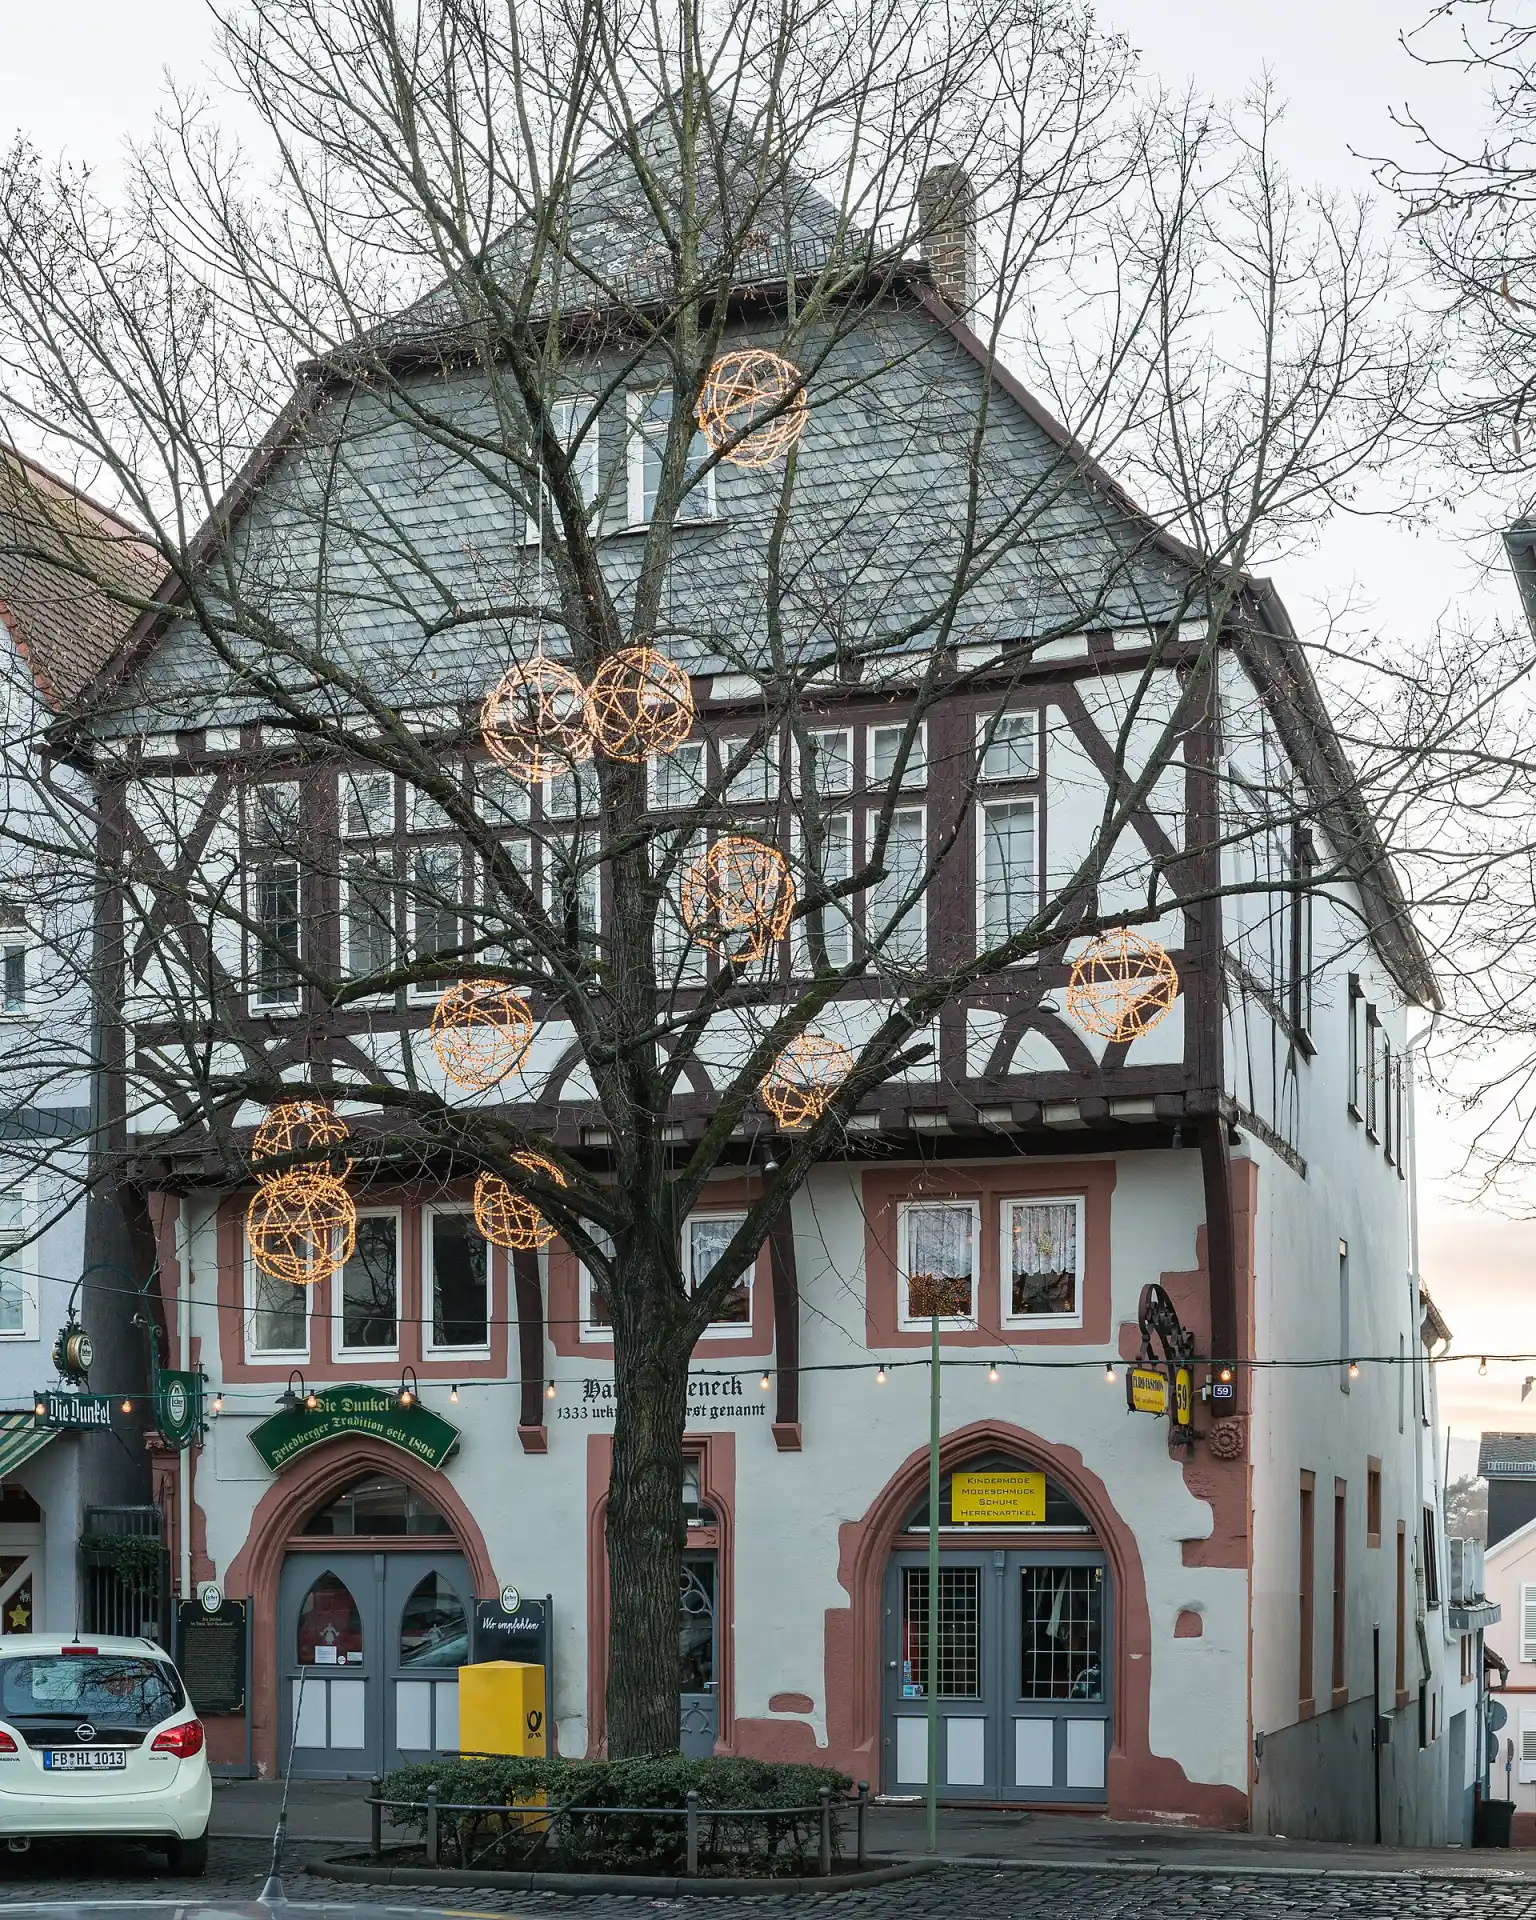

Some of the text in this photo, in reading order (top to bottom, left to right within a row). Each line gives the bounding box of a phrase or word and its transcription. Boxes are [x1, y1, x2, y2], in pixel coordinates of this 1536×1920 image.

[1177, 1383, 1187, 1411] 59
[1216, 1387, 1229, 1395] 59
[49, 1395, 111, 1424] Die Dunkel
[556, 1406, 588, 1419] 1333
[709, 1402, 766, 1420] genannt
[271, 1416, 436, 1463] Friedberger Tradition seit 1896
[978, 1498, 1018, 1506] SCHUHE
[498, 1617, 539, 1634] empfehlen
[52, 1752, 68, 1766] FB
[76, 1752, 91, 1765] HI
[94, 1752, 123, 1765] 1013
